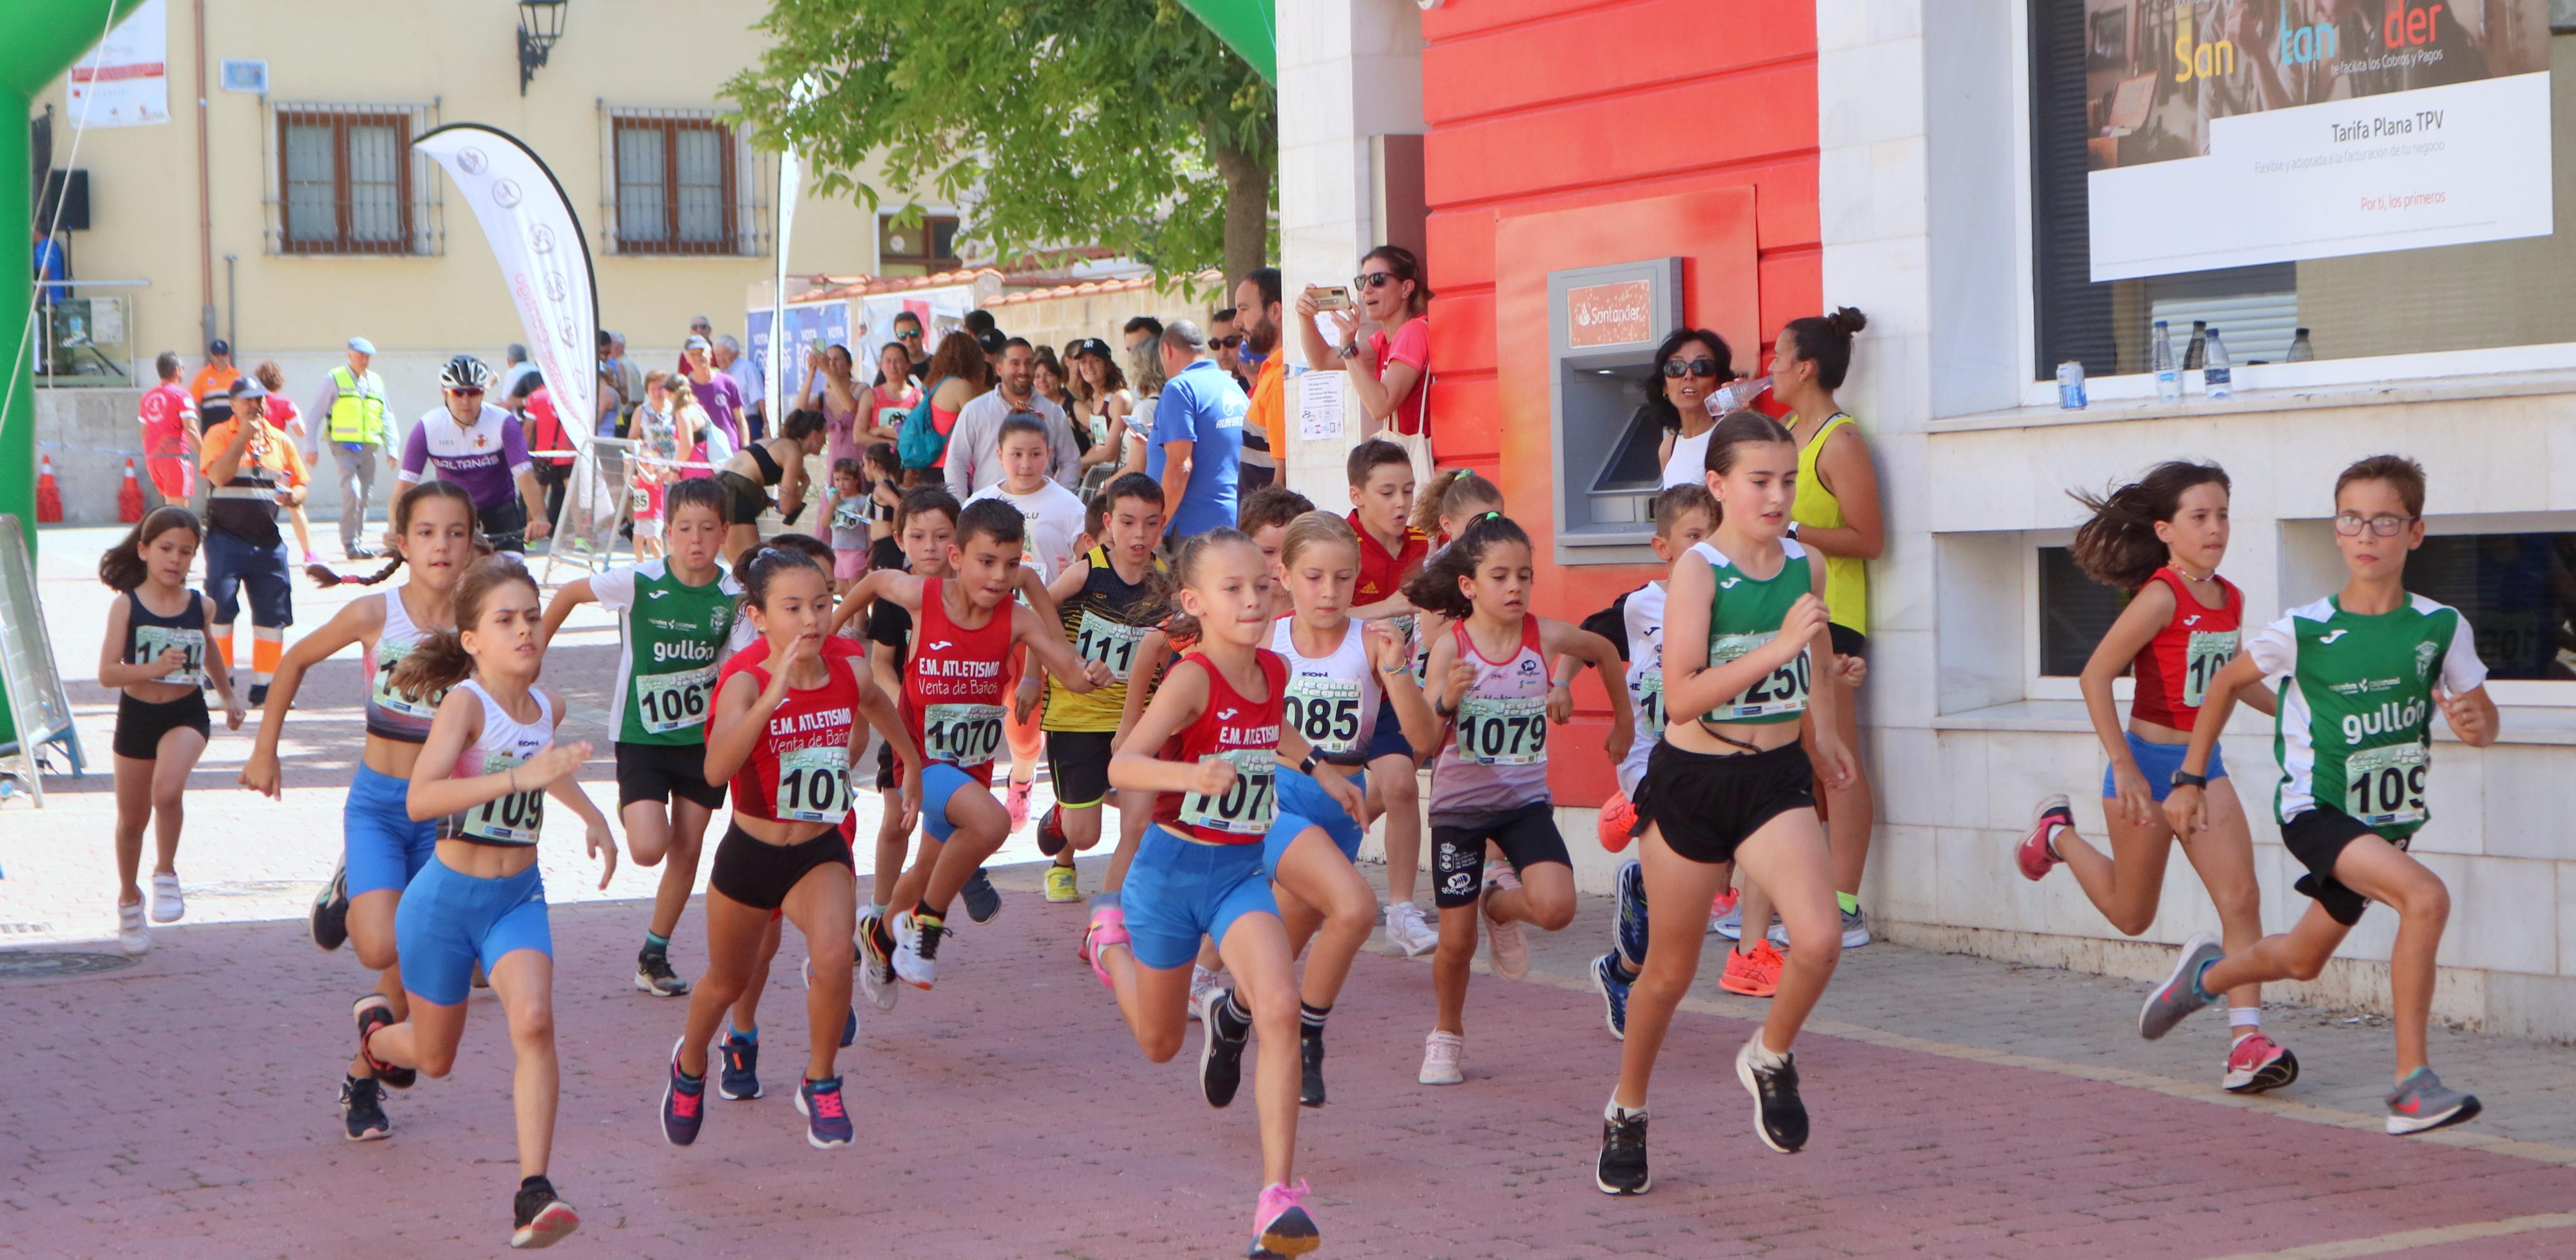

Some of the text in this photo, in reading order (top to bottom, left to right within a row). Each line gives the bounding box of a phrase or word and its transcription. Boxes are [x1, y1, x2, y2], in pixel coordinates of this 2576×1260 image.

[2175, 2, 2442, 82] San tan der
[2331, 49, 2443, 75] te facilita los Cobros y Pagos
[2332, 110, 2443, 143] Tarifa Plana TPV
[2254, 162, 2284, 174] Flexible
[2291, 155, 2327, 170] adaptada
[2335, 152, 2342, 164] la
[2345, 146, 2388, 163] facturación
[2389, 145, 2400, 157] de
[2403, 143, 2410, 155] tu
[2412, 140, 2445, 155] negocio
[2361, 191, 2446, 212] Por ti, los primeros
[1592, 304, 1639, 325] Santander
[827, 324, 844, 339] VOTA
[654, 640, 715, 662] gullón
[919, 658, 1000, 677] E.M. ATLETISMO
[1725, 649, 1810, 704] 250
[2191, 653, 2233, 693] 10
[919, 679, 997, 695] Venta de Baños
[1297, 679, 1356, 691] legua
[1302, 687, 1361, 699] legua
[770, 707, 851, 735] E.M. ATLETISMO
[2342, 696, 2426, 744] gullón
[769, 737, 804, 754] Venta
[809, 733, 823, 748] de
[928, 719, 1002, 757] 1070
[1220, 727, 1241, 744] E.M.
[1460, 714, 1546, 756] 1079
[1244, 755, 1274, 764] legu
[1249, 764, 1275, 772] legu
